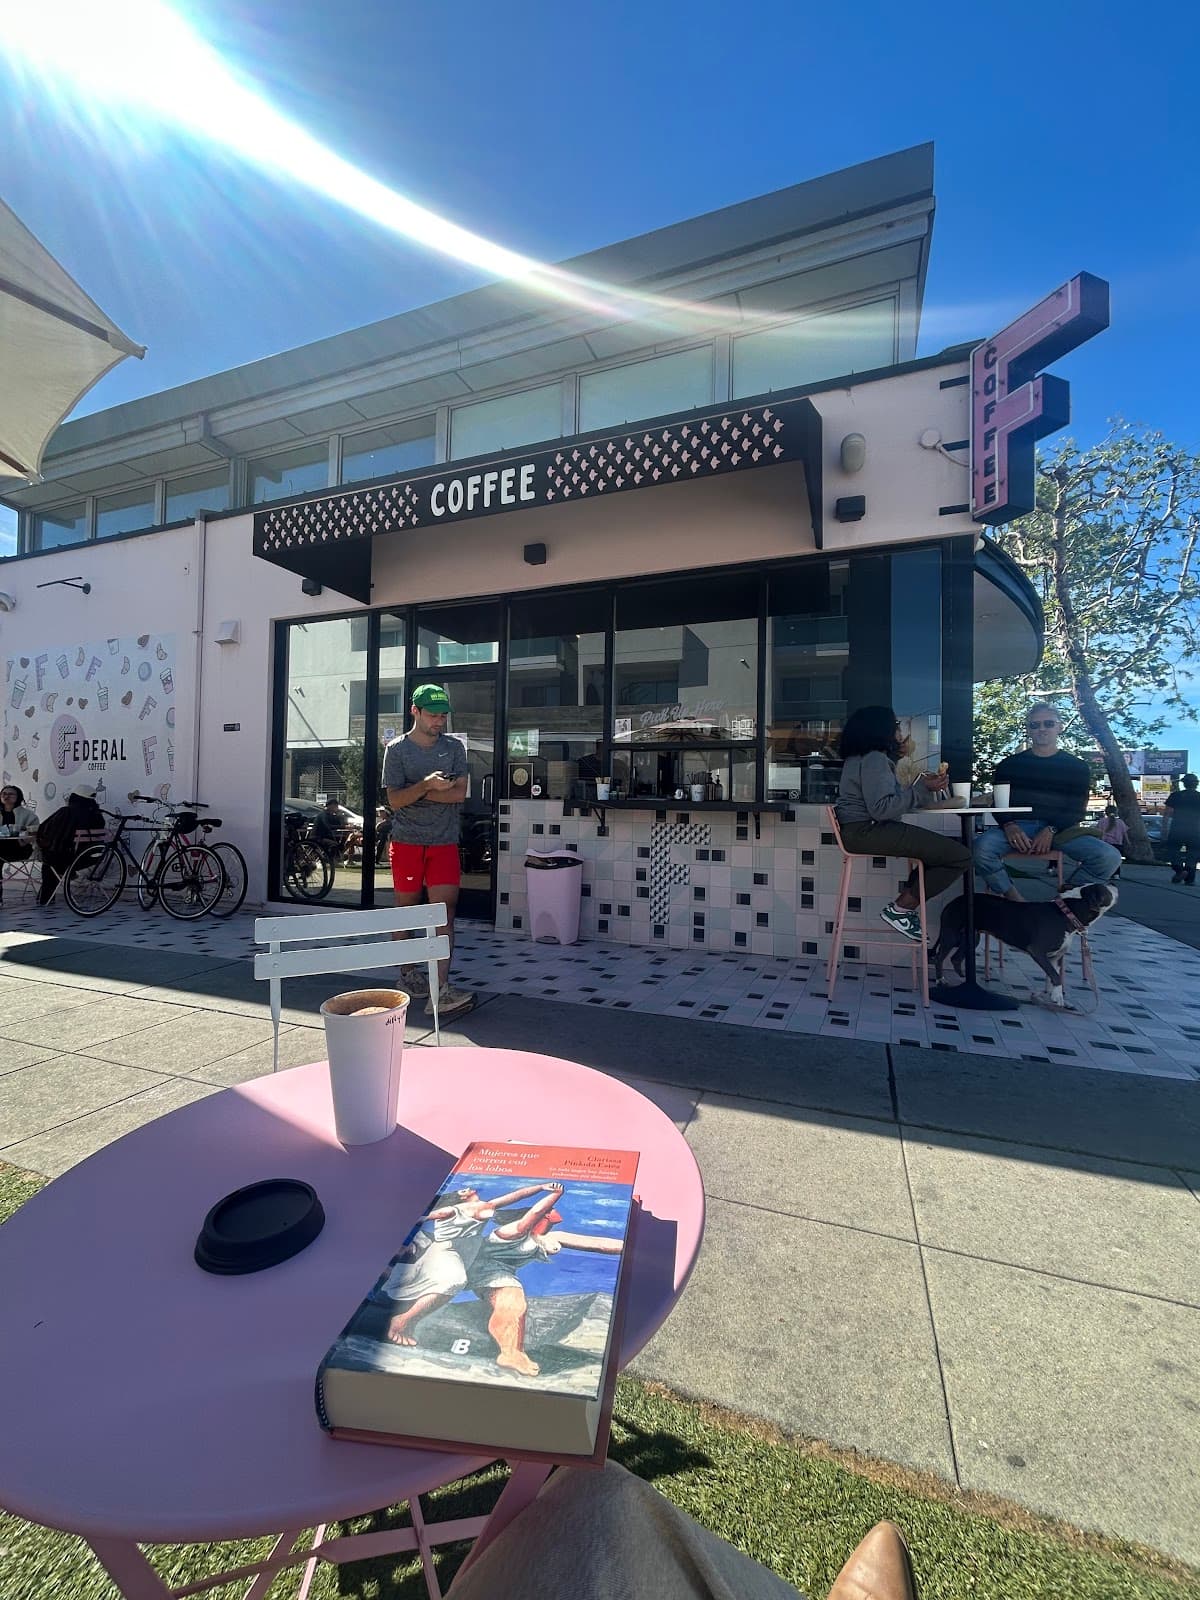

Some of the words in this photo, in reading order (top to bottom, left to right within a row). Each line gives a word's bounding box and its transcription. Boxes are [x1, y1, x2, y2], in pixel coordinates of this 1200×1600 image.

[983, 345, 997, 505] COFFEE
[430, 463, 536, 517] COFFEE
[57, 723, 127, 770] FEDERAL
[511, 735, 525, 752] A
[87, 762, 107, 771] COFFEE
[479, 1148, 519, 1158] Mujeres
[520, 1152, 541, 1160] que
[467, 1163, 484, 1171] los
[486, 1164, 513, 1173] lobos
[451, 1338, 471, 1355] B
